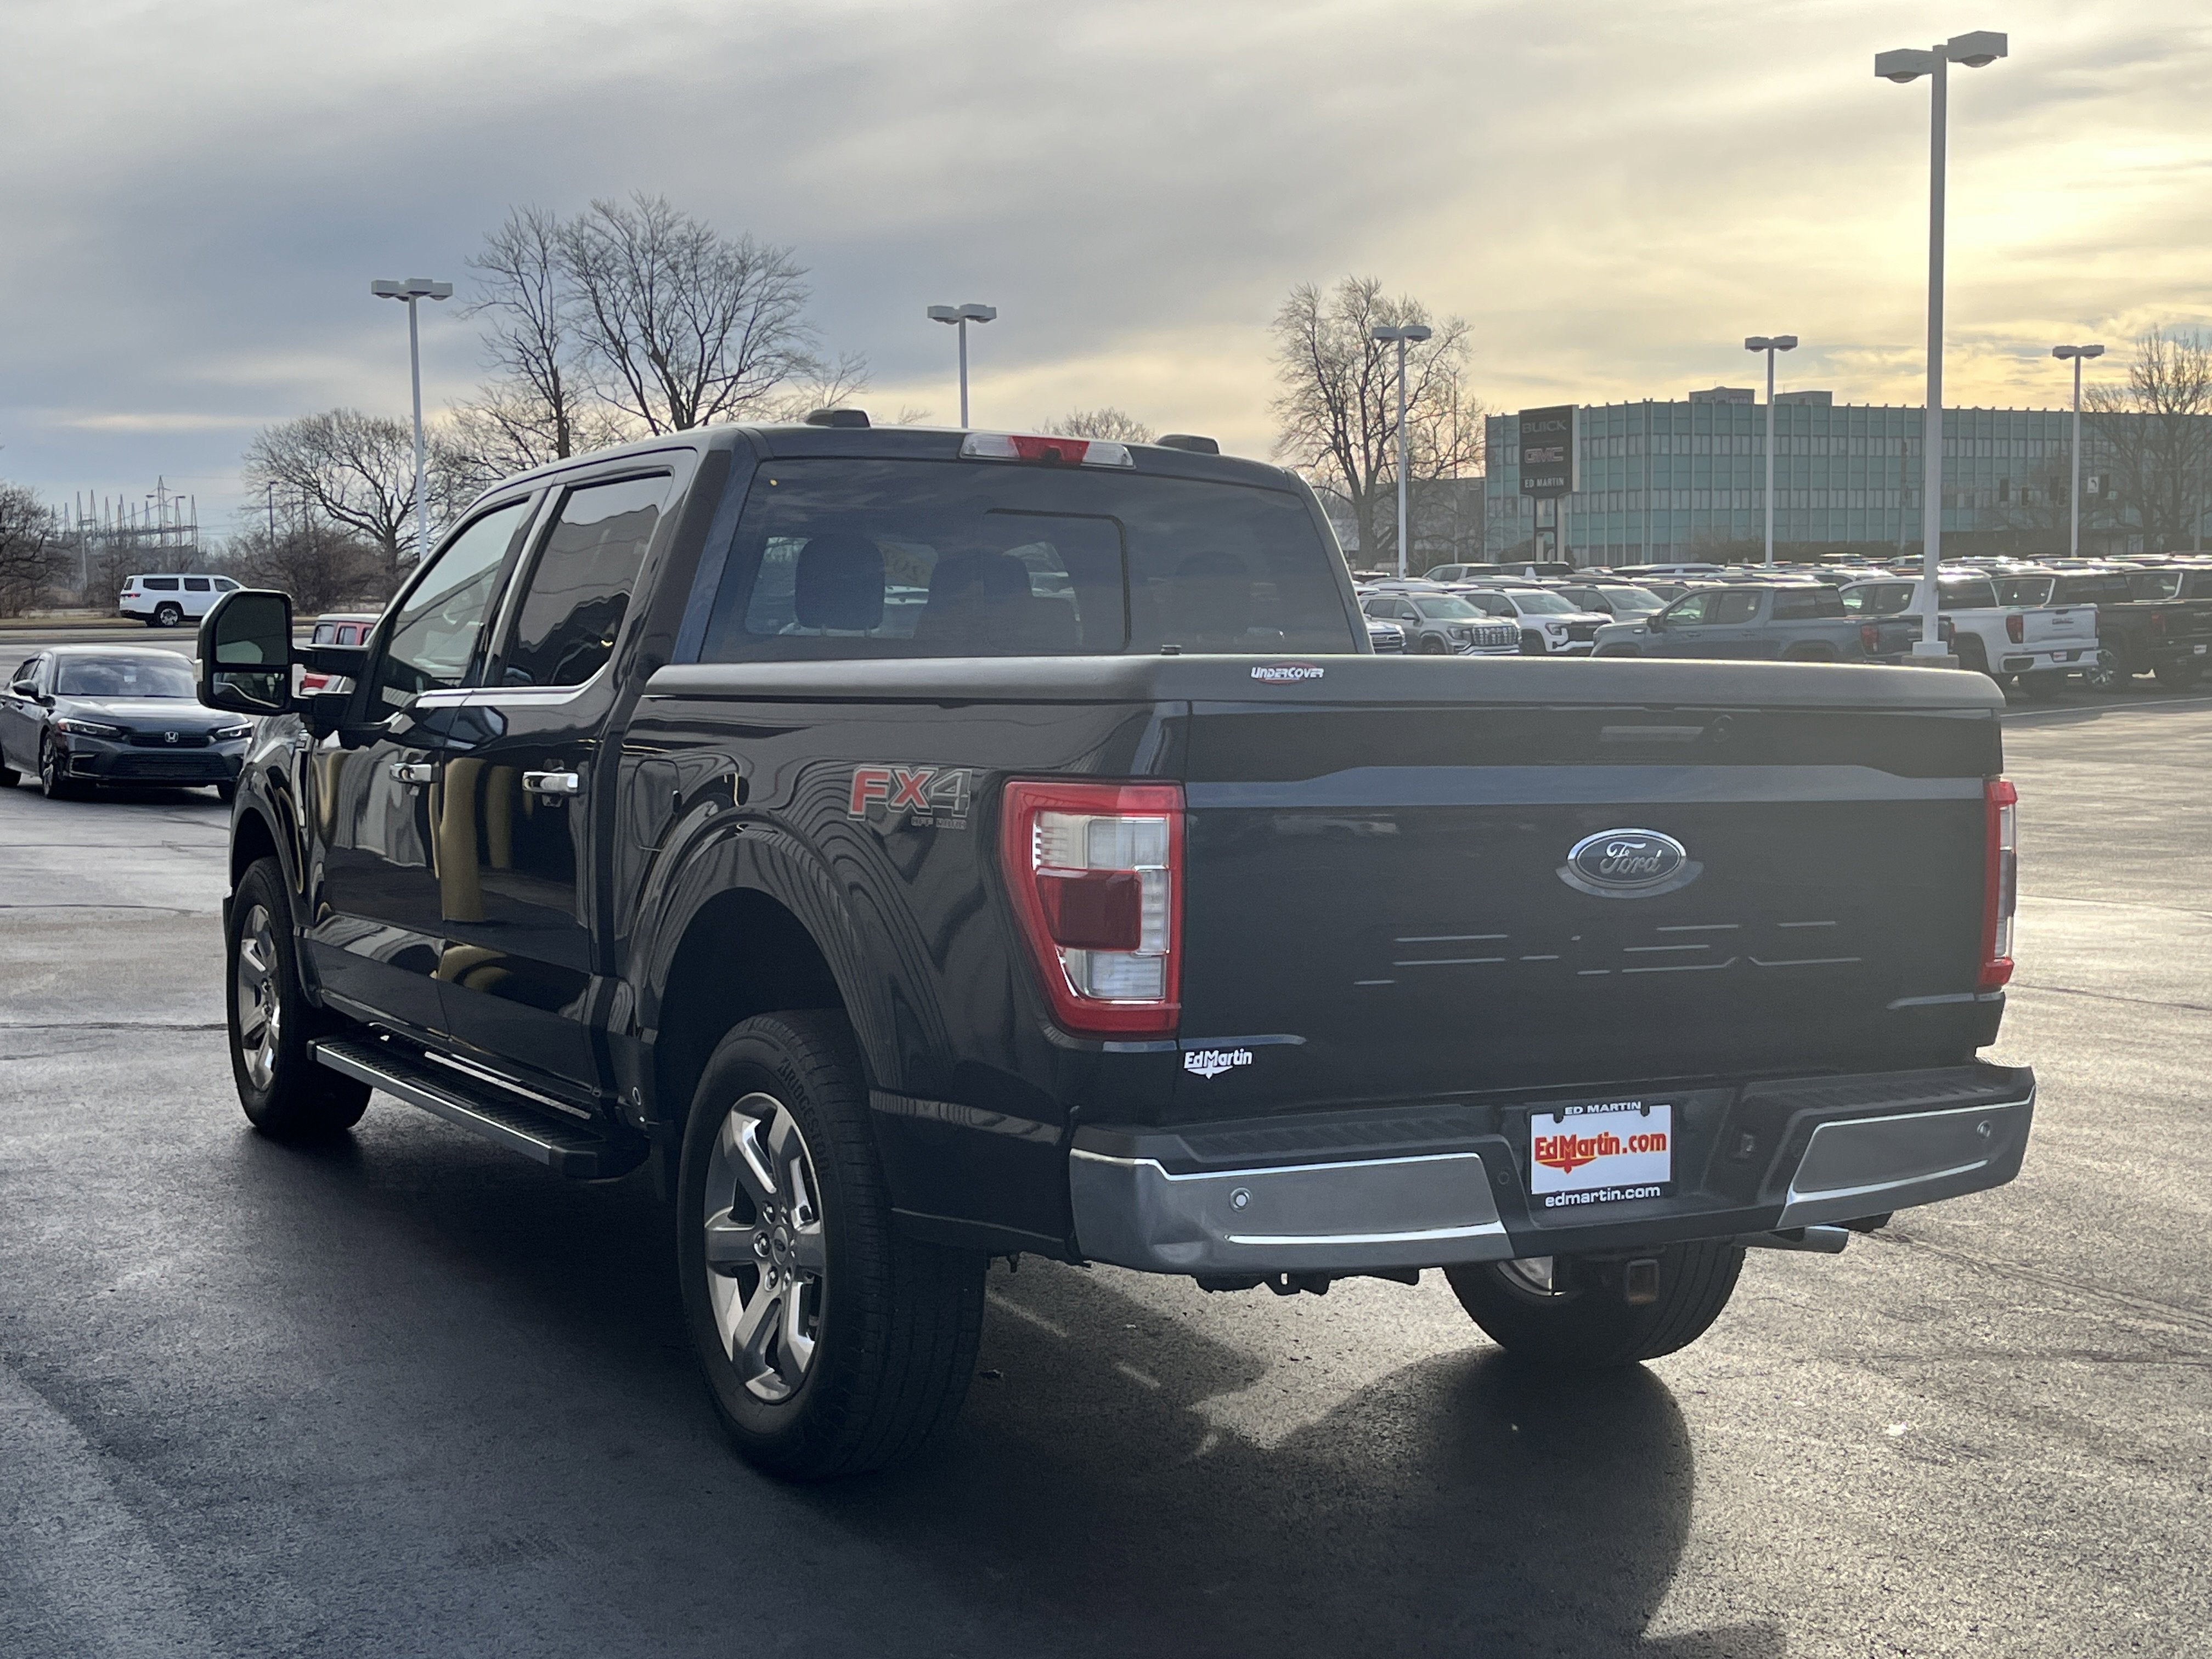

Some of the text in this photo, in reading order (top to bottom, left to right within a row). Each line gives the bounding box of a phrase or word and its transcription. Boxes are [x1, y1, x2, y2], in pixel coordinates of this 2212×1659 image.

[1522, 419, 1566, 433] BUICK
[1524, 447, 1564, 464] GMC
[1525, 477, 1564, 488] ED MARTIN
[847, 764, 973, 821] FX4
[1599, 841, 1662, 874] Ford
[1565, 1102, 1641, 1115] ED MARTIN
[1534, 1131, 1667, 1161] EdMartin.com
[1545, 1186, 1661, 1207] edmartin.com
